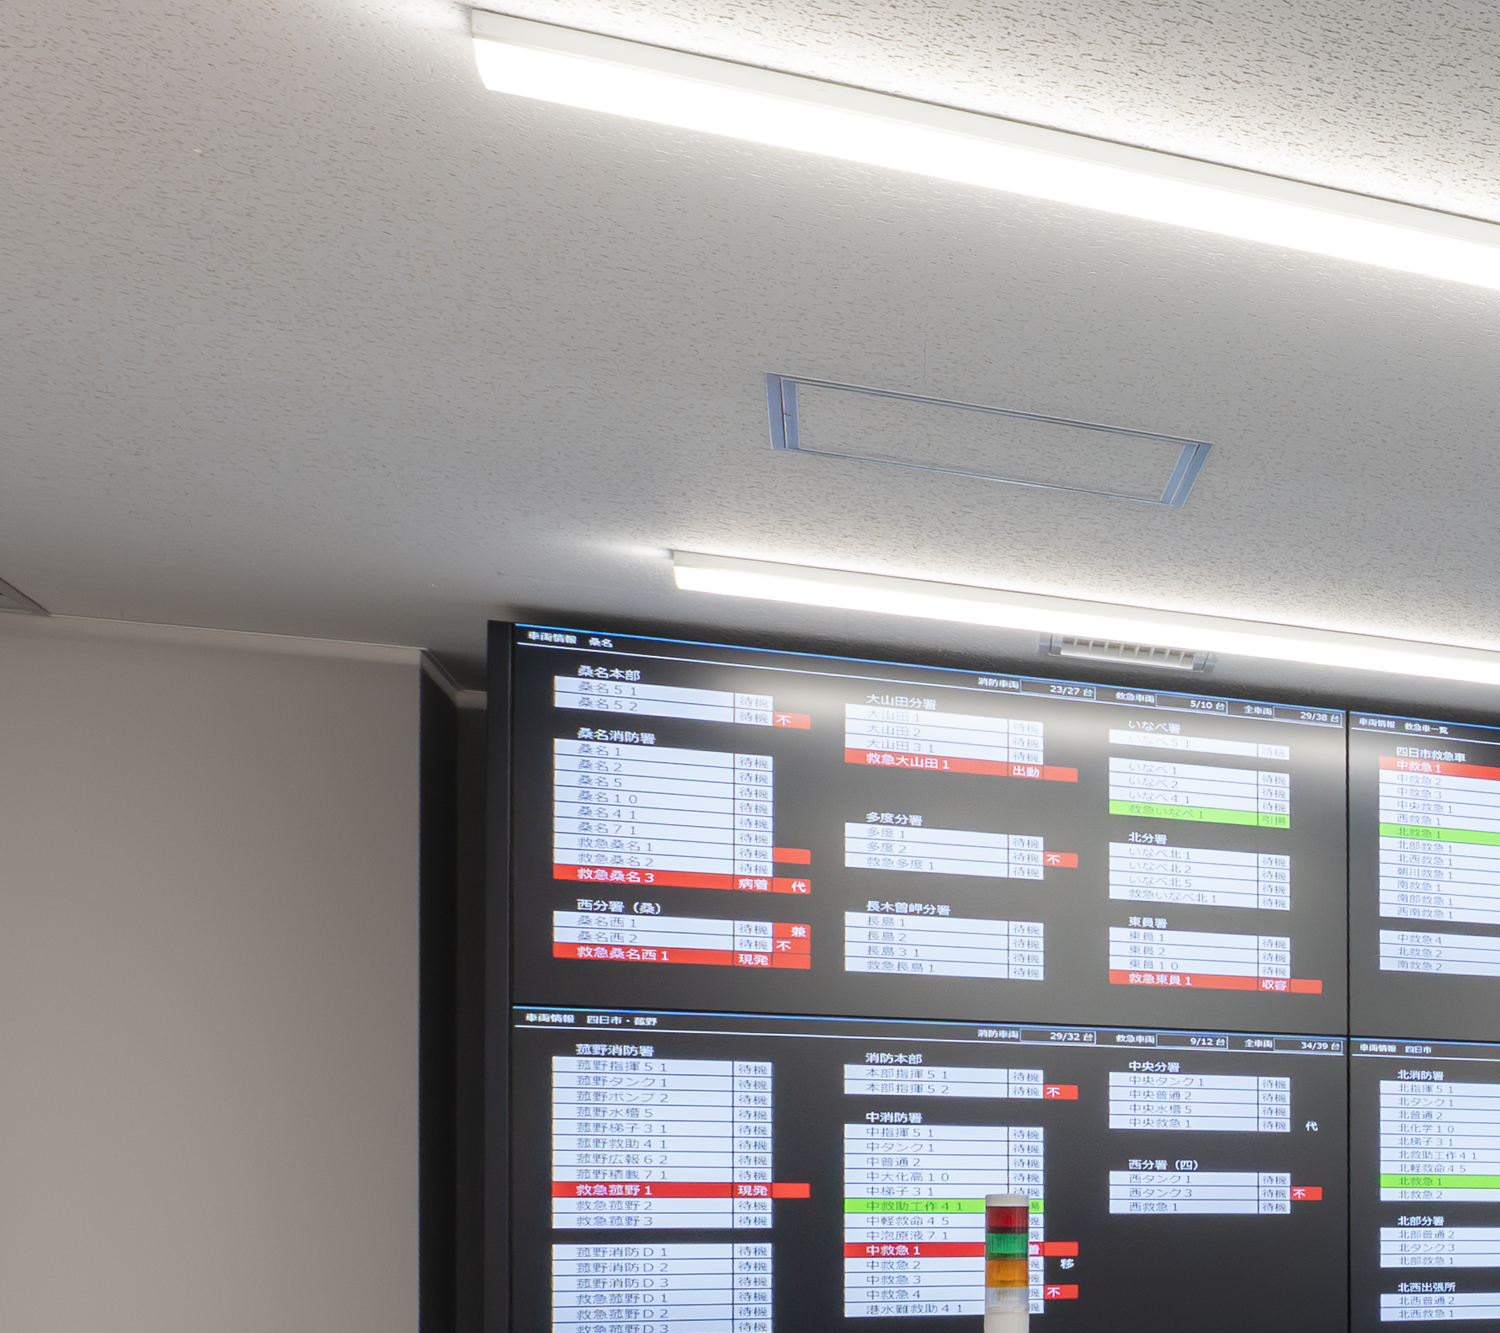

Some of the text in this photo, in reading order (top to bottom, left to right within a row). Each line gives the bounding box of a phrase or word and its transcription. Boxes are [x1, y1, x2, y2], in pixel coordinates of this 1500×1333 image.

[577, 665, 640, 681] 桑名本部
[866, 694, 937, 710] 大山田分署
[1128, 720, 1180, 734] いなべ署
[577, 728, 655, 744] 桑名消防署
[1396, 747, 1466, 762] 四日市救急車
[866, 752, 1040, 778] 救急大山田1 出動
[866, 812, 923, 826] 多度分署
[1128, 832, 1167, 844] 北分署
[577, 868, 806, 892] 救急桑名3 病着 代
[1128, 916, 1168, 928] 東員署
[577, 946, 768, 965] 救急桑名西1 現発
[866, 1052, 922, 1064] 消防本部
[1129, 1061, 1180, 1073] 中央分署
[1398, 1070, 1444, 1081] 北消防署
[866, 1112, 922, 1123] 中消防署
[1306, 1121, 1318, 1131] 代
[576, 1185, 768, 1196] 救急菰野1 現発
[1398, 1216, 1444, 1226] 北部分署
[866, 1245, 920, 1256] 中救急1
[1398, 1282, 1456, 1292] 北西出張所
